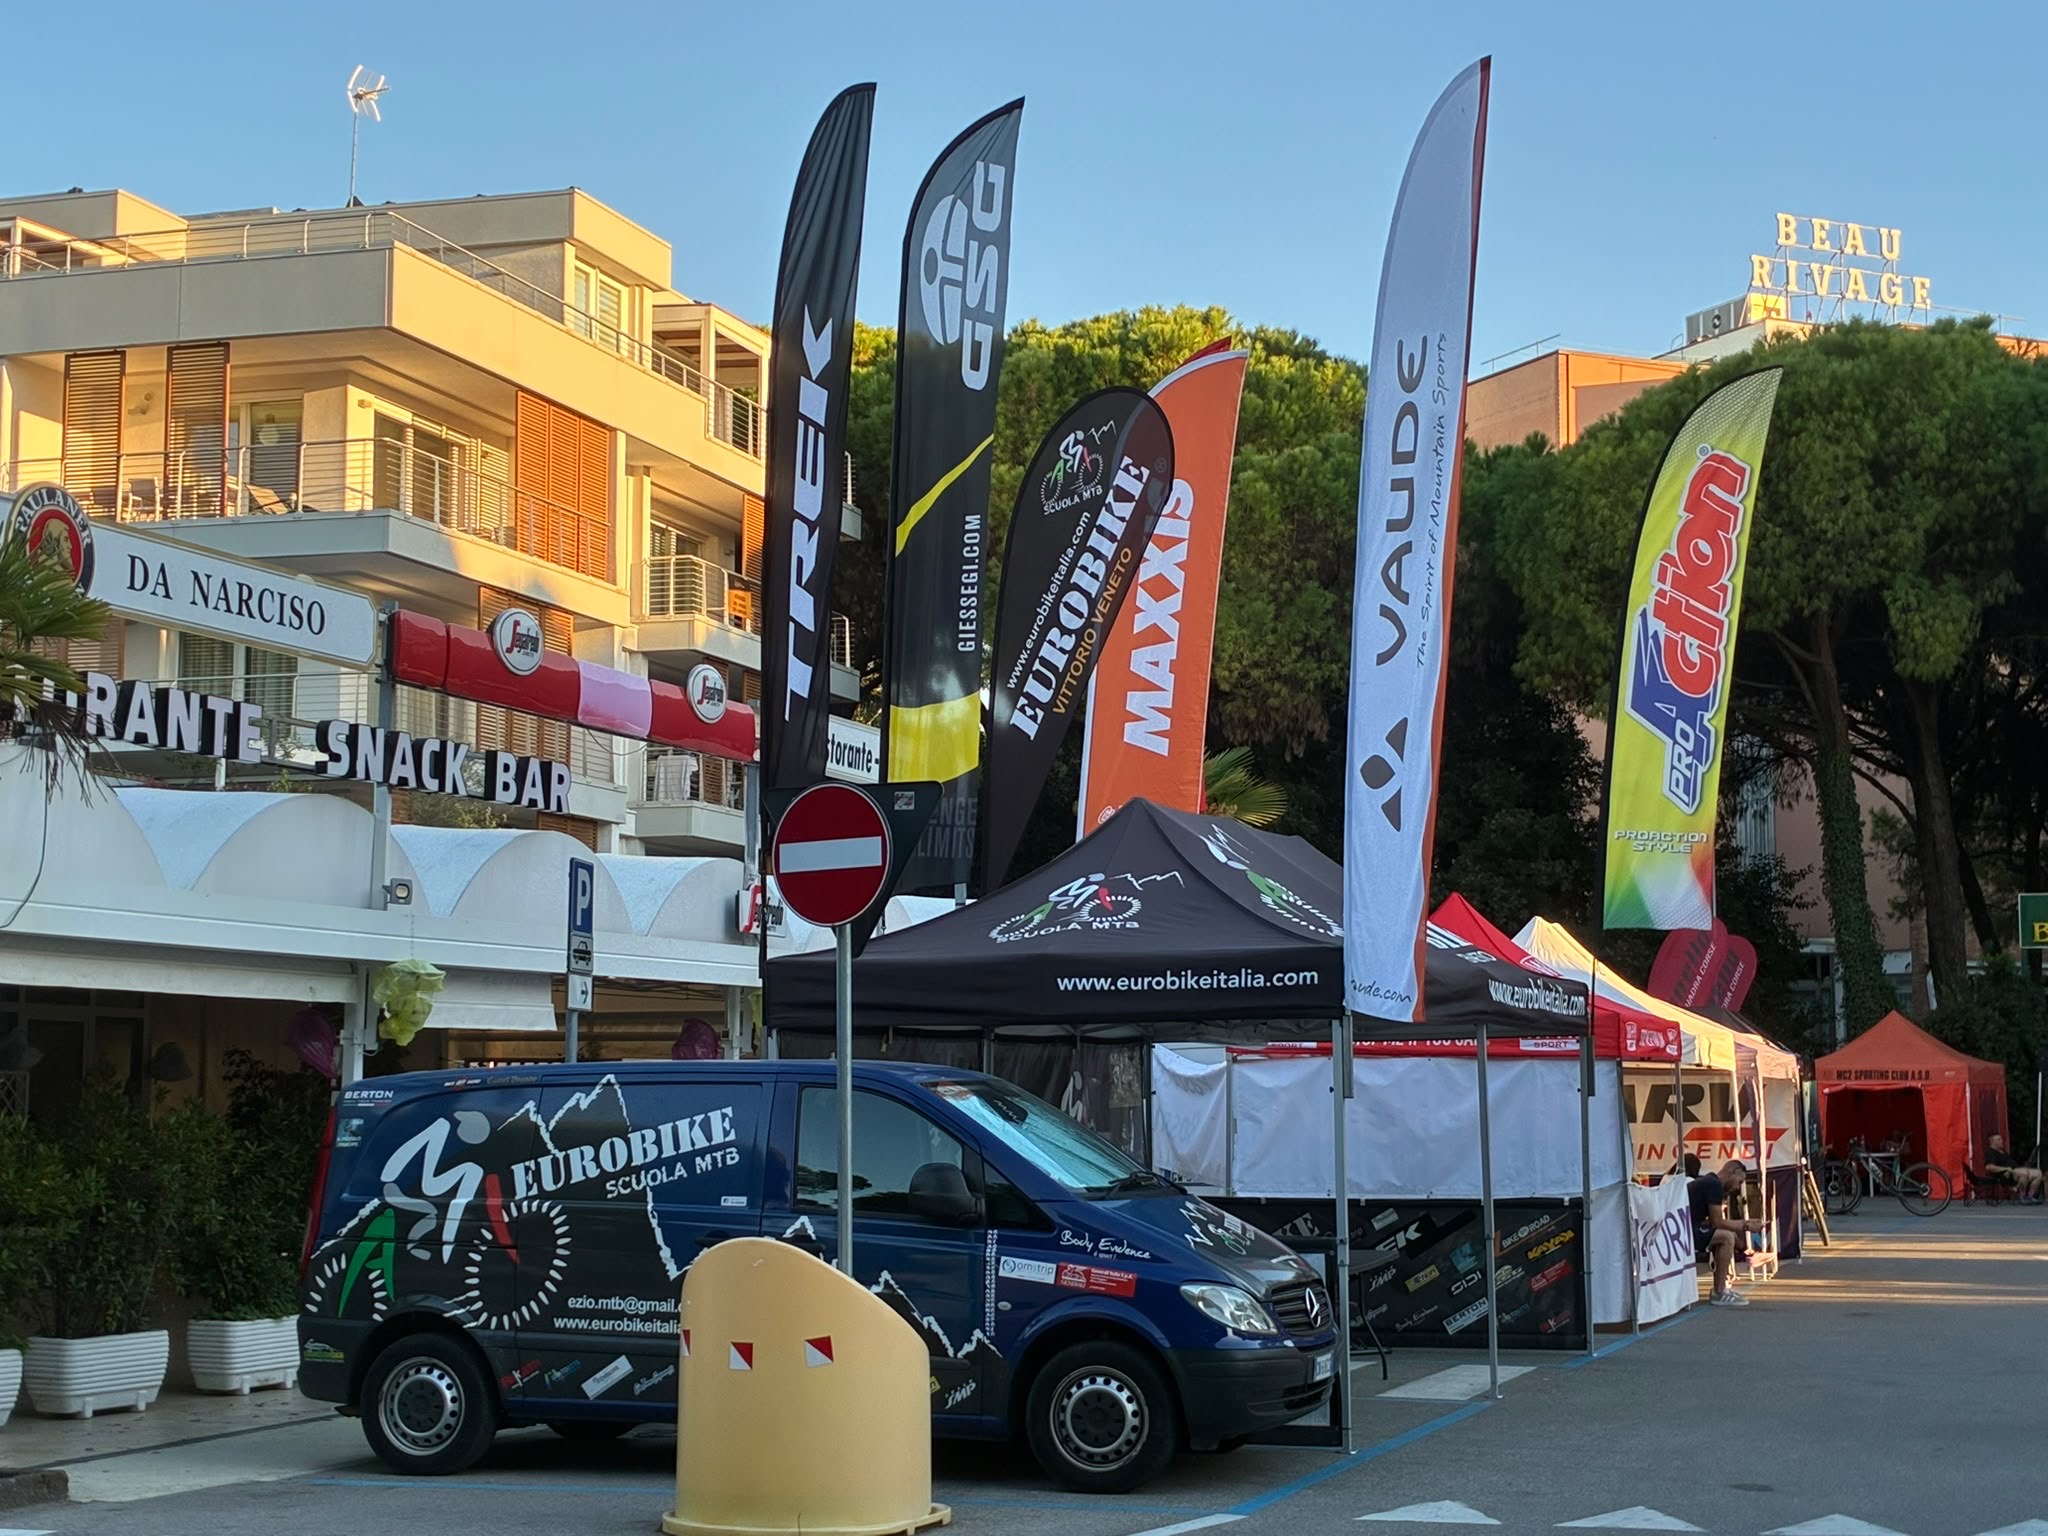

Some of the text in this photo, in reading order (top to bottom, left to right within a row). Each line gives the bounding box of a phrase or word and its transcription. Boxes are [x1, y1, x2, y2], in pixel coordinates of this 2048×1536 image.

[1776, 212, 1901, 261] BEAU
[961, 160, 1006, 392] GSG
[1751, 254, 1932, 310] RIVAGE
[15, 487, 92, 549] PAULANER
[784, 303, 833, 722] TREK
[1042, 484, 1103, 516] SCUOLA MTB
[1375, 335, 1428, 667] VAUDE
[1416, 332, 1450, 669] The Spirit of Mountain Sports
[127, 554, 326, 636] DA NARCISO
[958, 513, 981, 653] GIESSEGI.COM
[1006, 511, 1092, 690] www.eurobikeitalia.com
[1009, 455, 1150, 742] EUROBIKE
[1052, 546, 1132, 716] VITTORIO VENETO
[1123, 478, 1194, 757] MAXXIS
[318, 720, 471, 797] SNACK
[488, 750, 573, 814] BAR
[1632, 842, 1693, 854] STYLE
[575, 867, 591, 927] P
[743, 885, 784, 933] Segfredo
[996, 920, 1140, 943] SCUOLA MTB
[1056, 968, 1319, 993] www.eurobikeitalia.com
[1488, 978, 1587, 1017] www.eurobikeitalia.com
[1533, 1041, 1569, 1049] SPORT
[343, 1090, 395, 1099] BERTON
[511, 1106, 737, 1201] EUROBIKE
[605, 1146, 741, 1199] SCUOLA MTB
[1060, 1229, 1094, 1252] Body
[1445, 1298, 1487, 1326] BERTON
